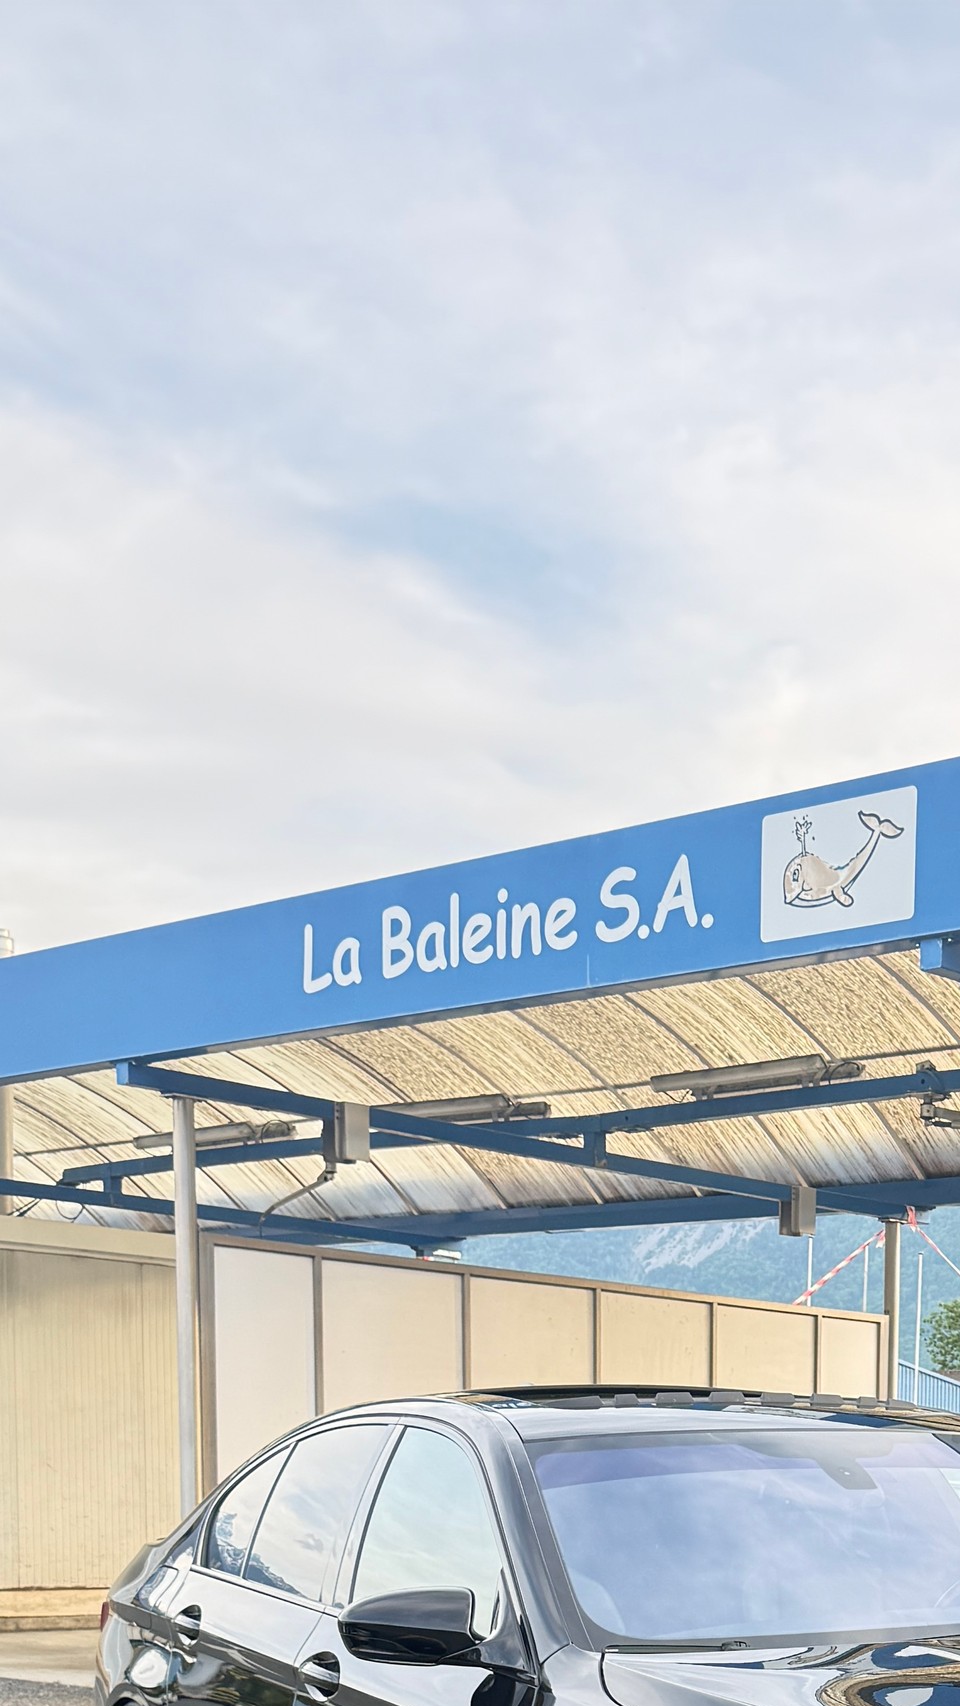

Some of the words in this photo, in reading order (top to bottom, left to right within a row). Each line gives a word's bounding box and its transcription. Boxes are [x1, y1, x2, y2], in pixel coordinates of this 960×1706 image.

[303, 924, 362, 994] La
[381, 888, 578, 980] Baleine
[595, 853, 714, 943] S.A.
